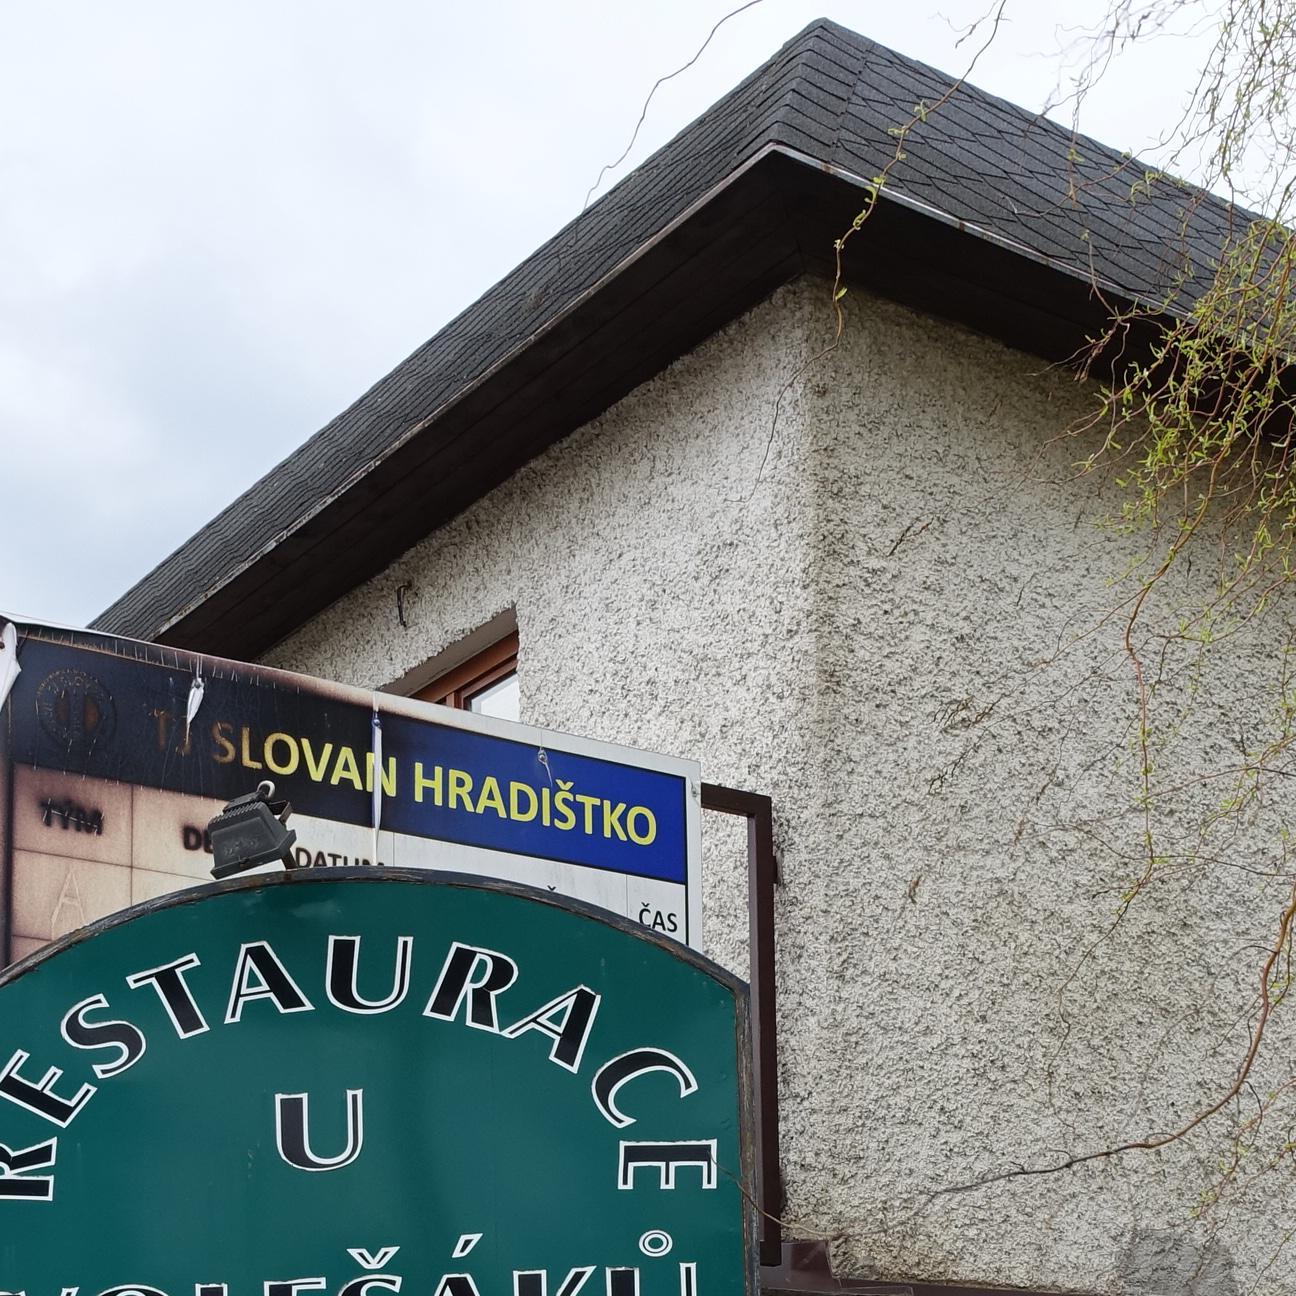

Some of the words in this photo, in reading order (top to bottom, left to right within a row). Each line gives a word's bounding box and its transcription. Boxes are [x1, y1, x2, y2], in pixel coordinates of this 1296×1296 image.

[212, 720, 397, 797] SLOVAN
[415, 761, 657, 846] HRADIŠTKO
[639, 902, 678, 932] ČAS
[275, 1089, 363, 1171] U
